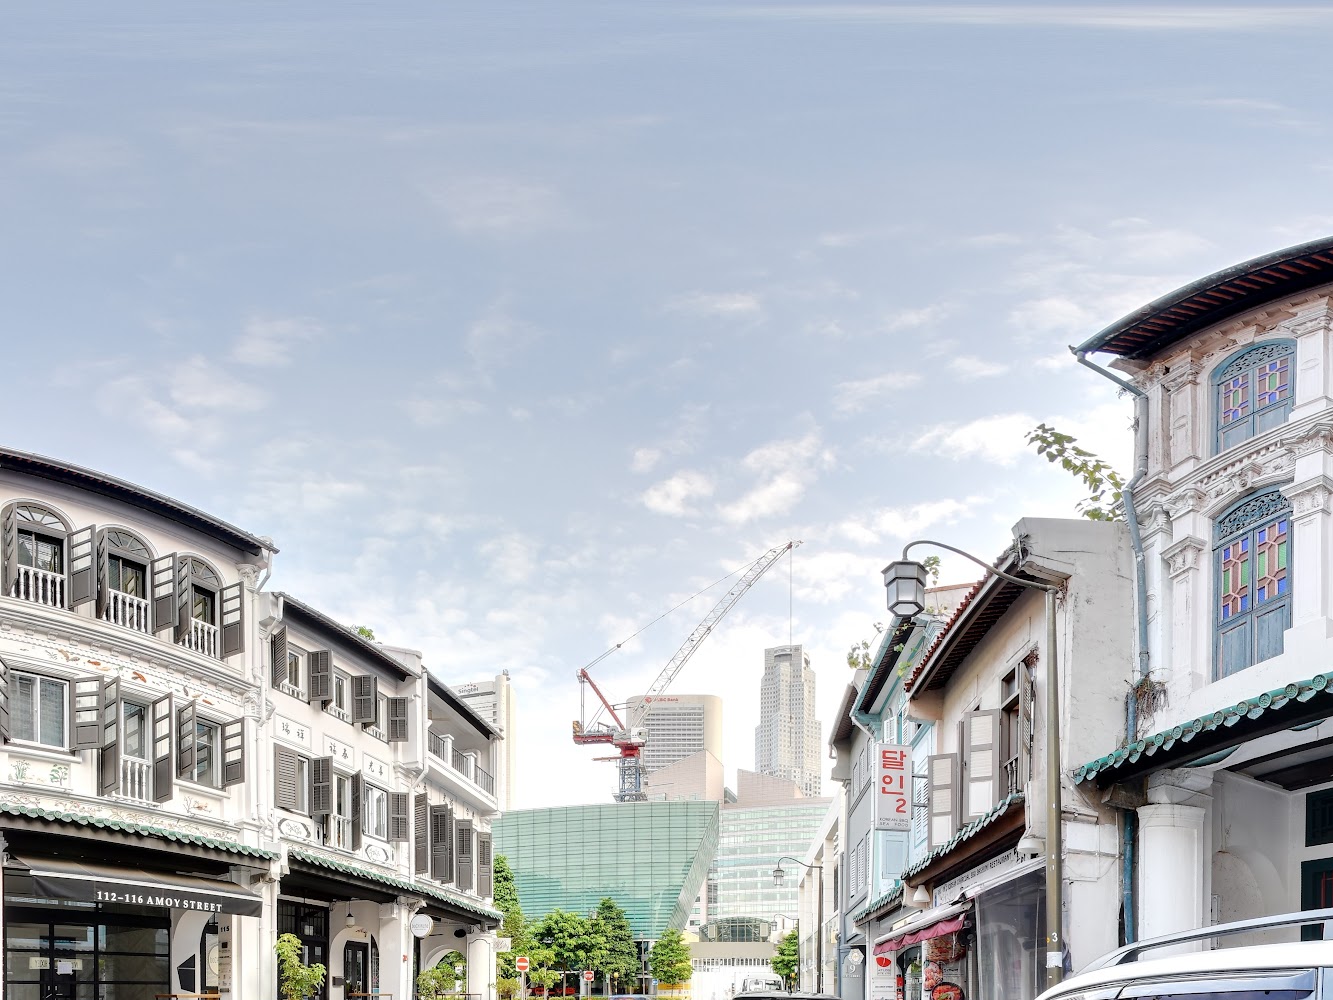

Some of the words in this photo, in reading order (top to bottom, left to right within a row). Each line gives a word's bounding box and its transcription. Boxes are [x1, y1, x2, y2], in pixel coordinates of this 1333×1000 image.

[882, 750, 907, 796] 달인
[895, 798, 907, 813] 2
[989, 852, 1012, 868] RESTAURANT
[97, 891, 144, 904] 112-116
[146, 896, 181, 908] AMOY
[183, 900, 222, 912] STREET
[1051, 932, 1058, 942] 3
